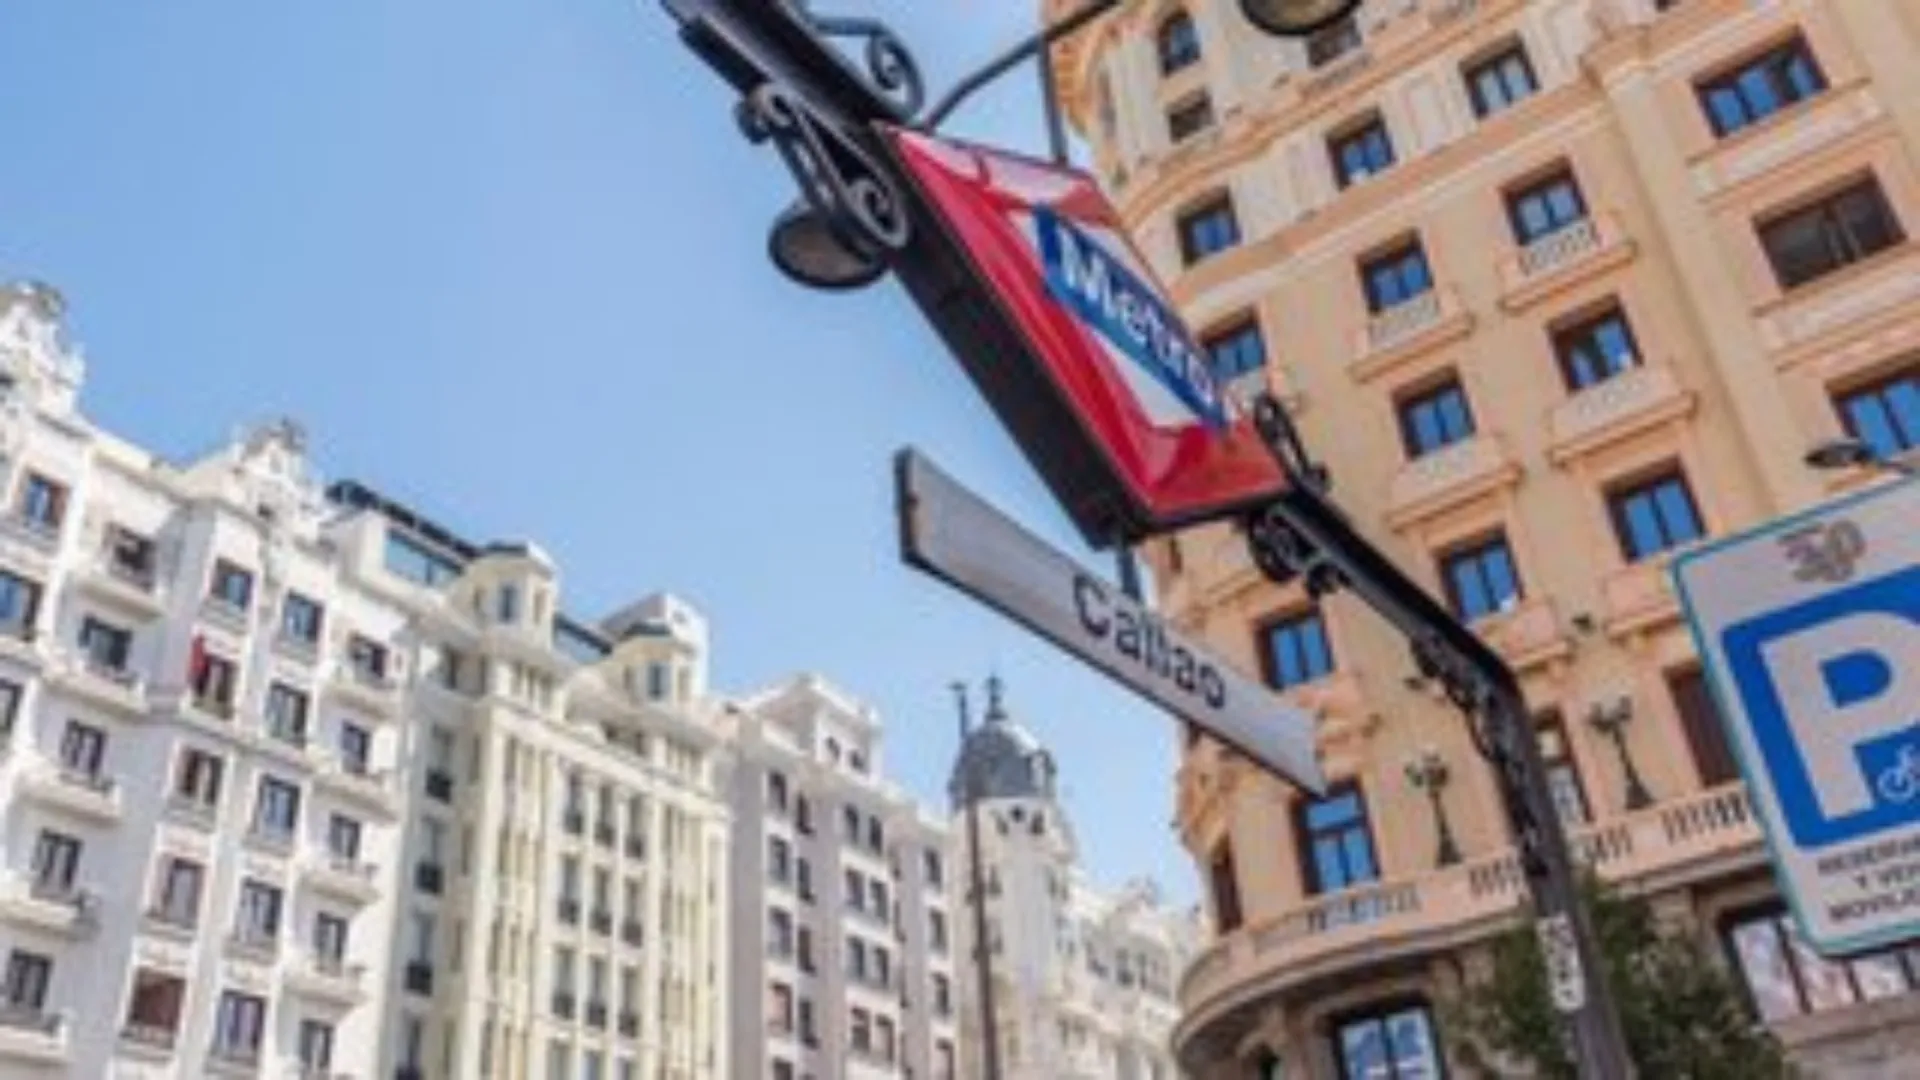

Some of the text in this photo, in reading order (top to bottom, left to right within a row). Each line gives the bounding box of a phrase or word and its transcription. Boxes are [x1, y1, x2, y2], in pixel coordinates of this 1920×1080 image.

[1057, 228, 1218, 407] Metro
[1073, 574, 1226, 709] Callao
[1759, 611, 1920, 821] P
